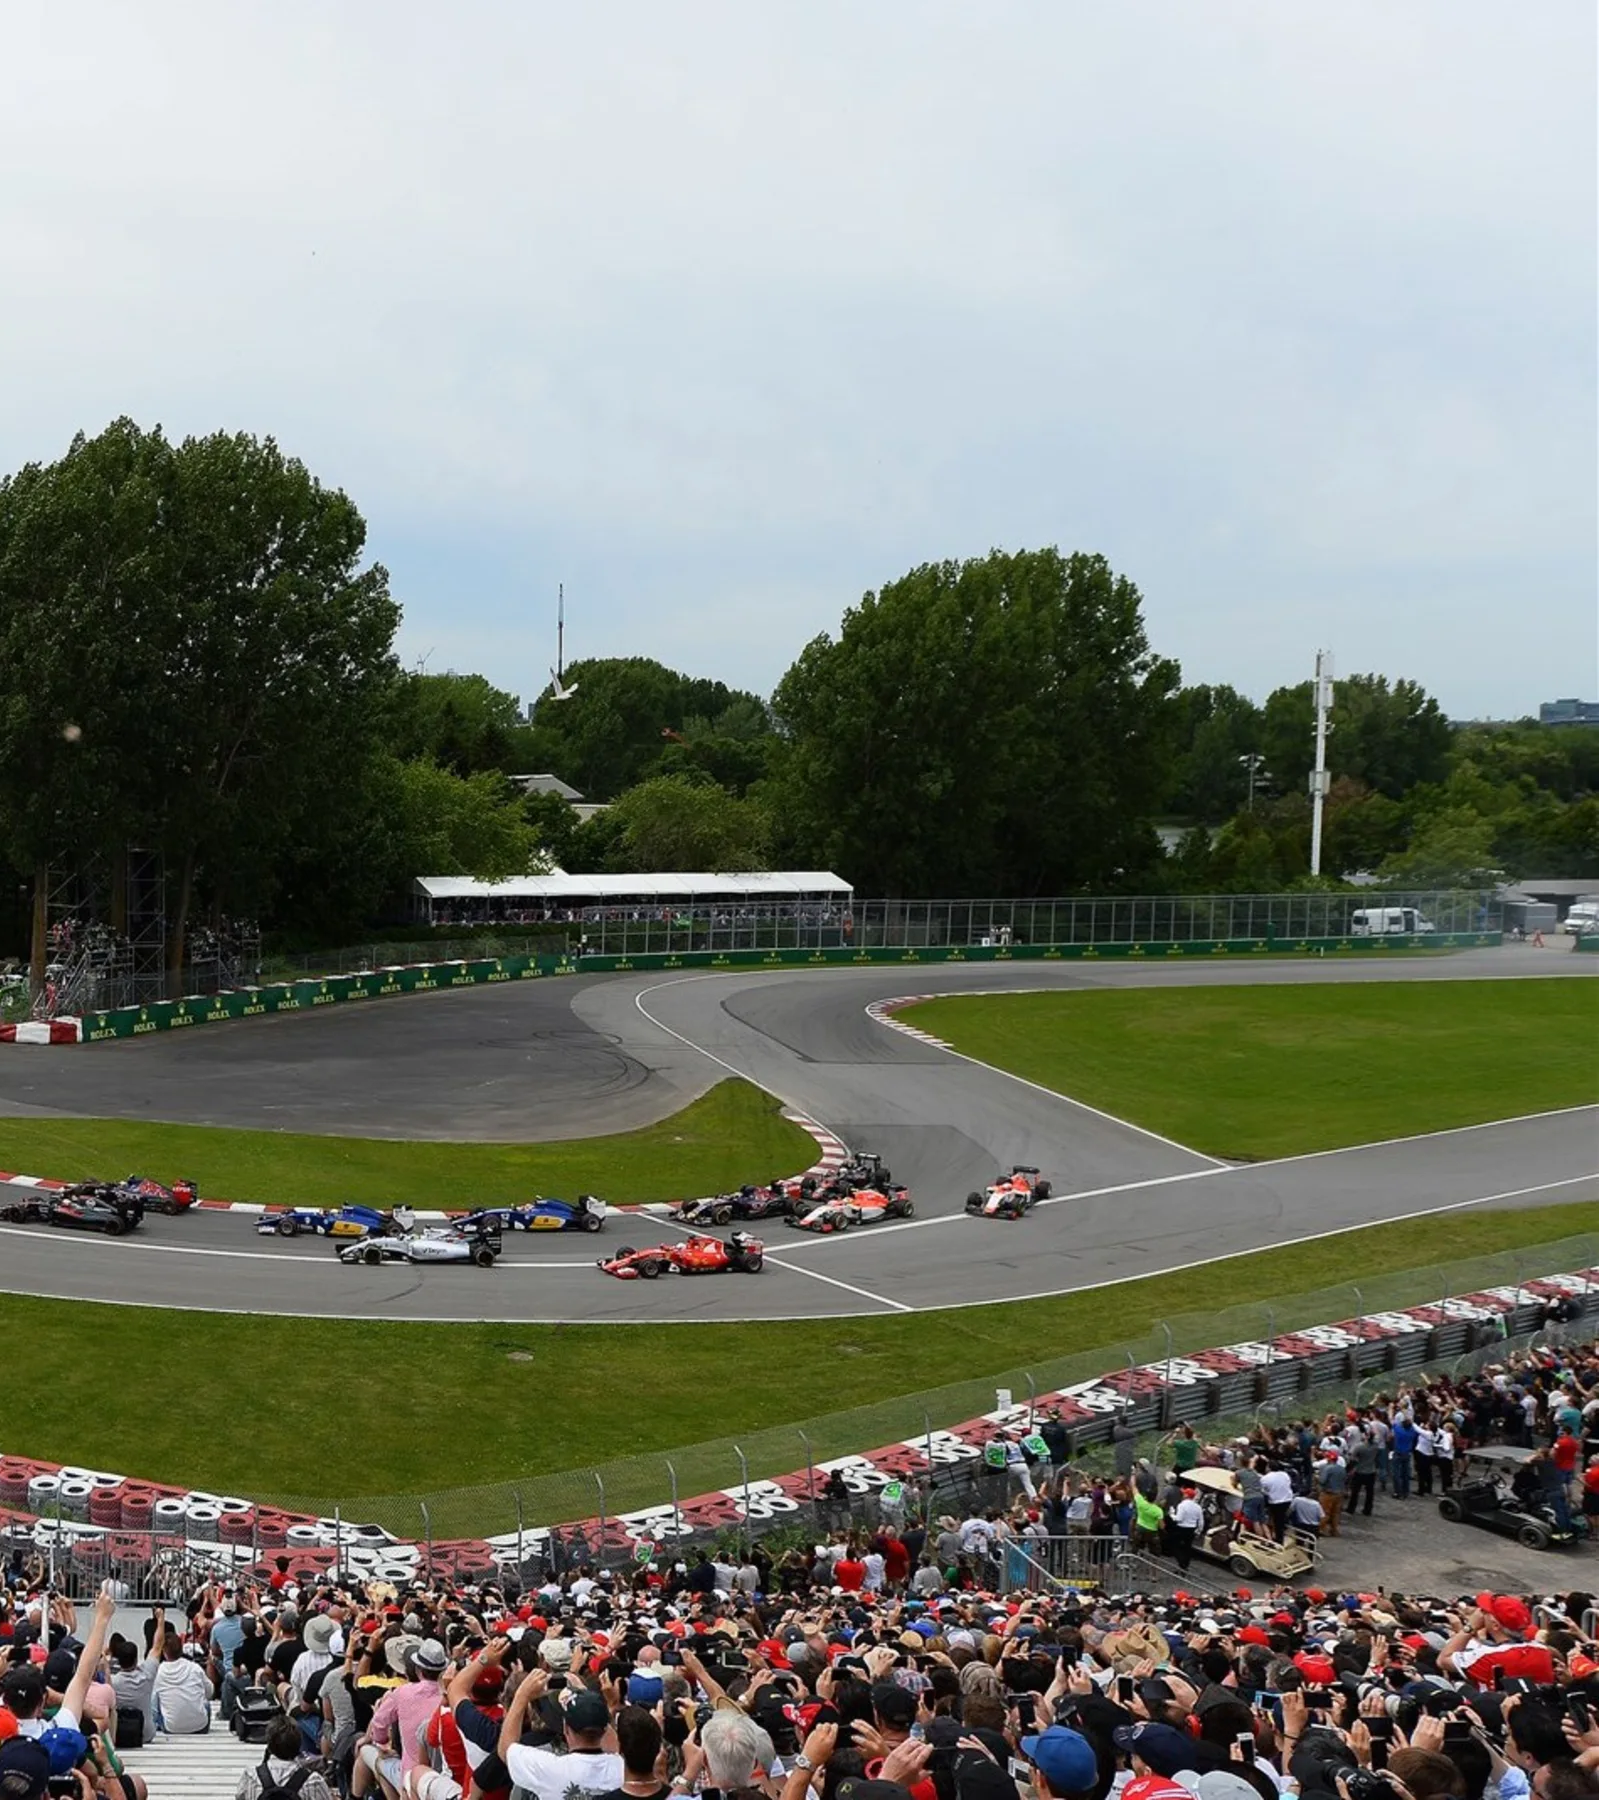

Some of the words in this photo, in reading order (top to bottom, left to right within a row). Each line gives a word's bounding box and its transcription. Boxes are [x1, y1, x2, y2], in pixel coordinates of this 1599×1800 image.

[521, 968, 543, 978] ROLEX
[555, 965, 576, 975] ROLEX
[452, 974, 475, 985] ROLEX
[488, 971, 510, 981] ROLEX
[380, 983, 401, 994] ROLEX
[415, 979, 437, 989] ROLEX
[313, 994, 335, 1004] ROLEX
[348, 988, 368, 999] ROLEX
[243, 1003, 266, 1015] ROLEX
[278, 999, 300, 1010] ROLEX
[170, 1015, 194, 1026] ROLEX
[207, 1009, 230, 1021] ROLEX
[133, 1021, 157, 1033] ROLEX
[90, 1027, 117, 1040] ROLEX
